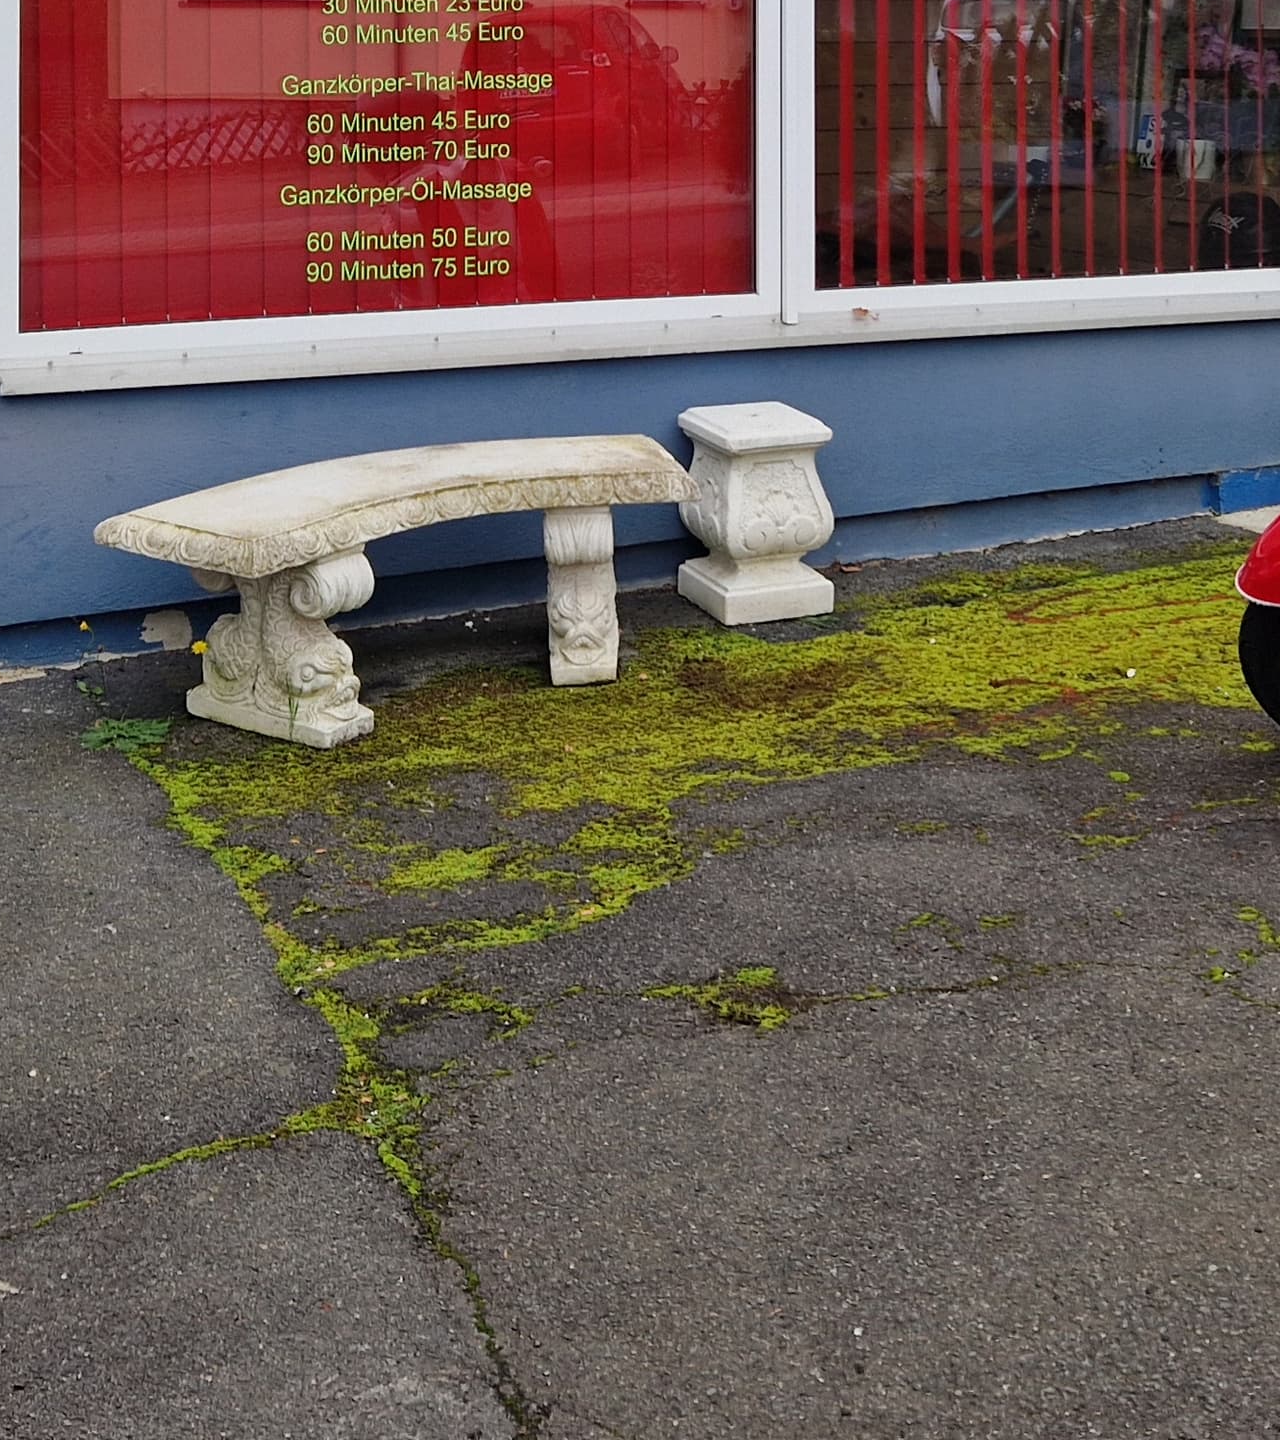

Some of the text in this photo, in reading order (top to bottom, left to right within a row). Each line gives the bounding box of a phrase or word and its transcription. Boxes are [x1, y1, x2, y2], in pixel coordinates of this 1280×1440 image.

[322, 22, 524, 45] 60 Minuten 45 Euro
[282, 70, 553, 97] Ganzkörper-Thai-Massage
[307, 110, 510, 134] 60 Minuten 45 Euro
[307, 139, 510, 164] 90 Minuten 70 Euro
[280, 177, 532, 206] Ganzkörper-Öl-Massage
[307, 227, 510, 252] 60 Minuten 50 Euro
[306, 256, 510, 282] 90 Minuten 75 Euro
